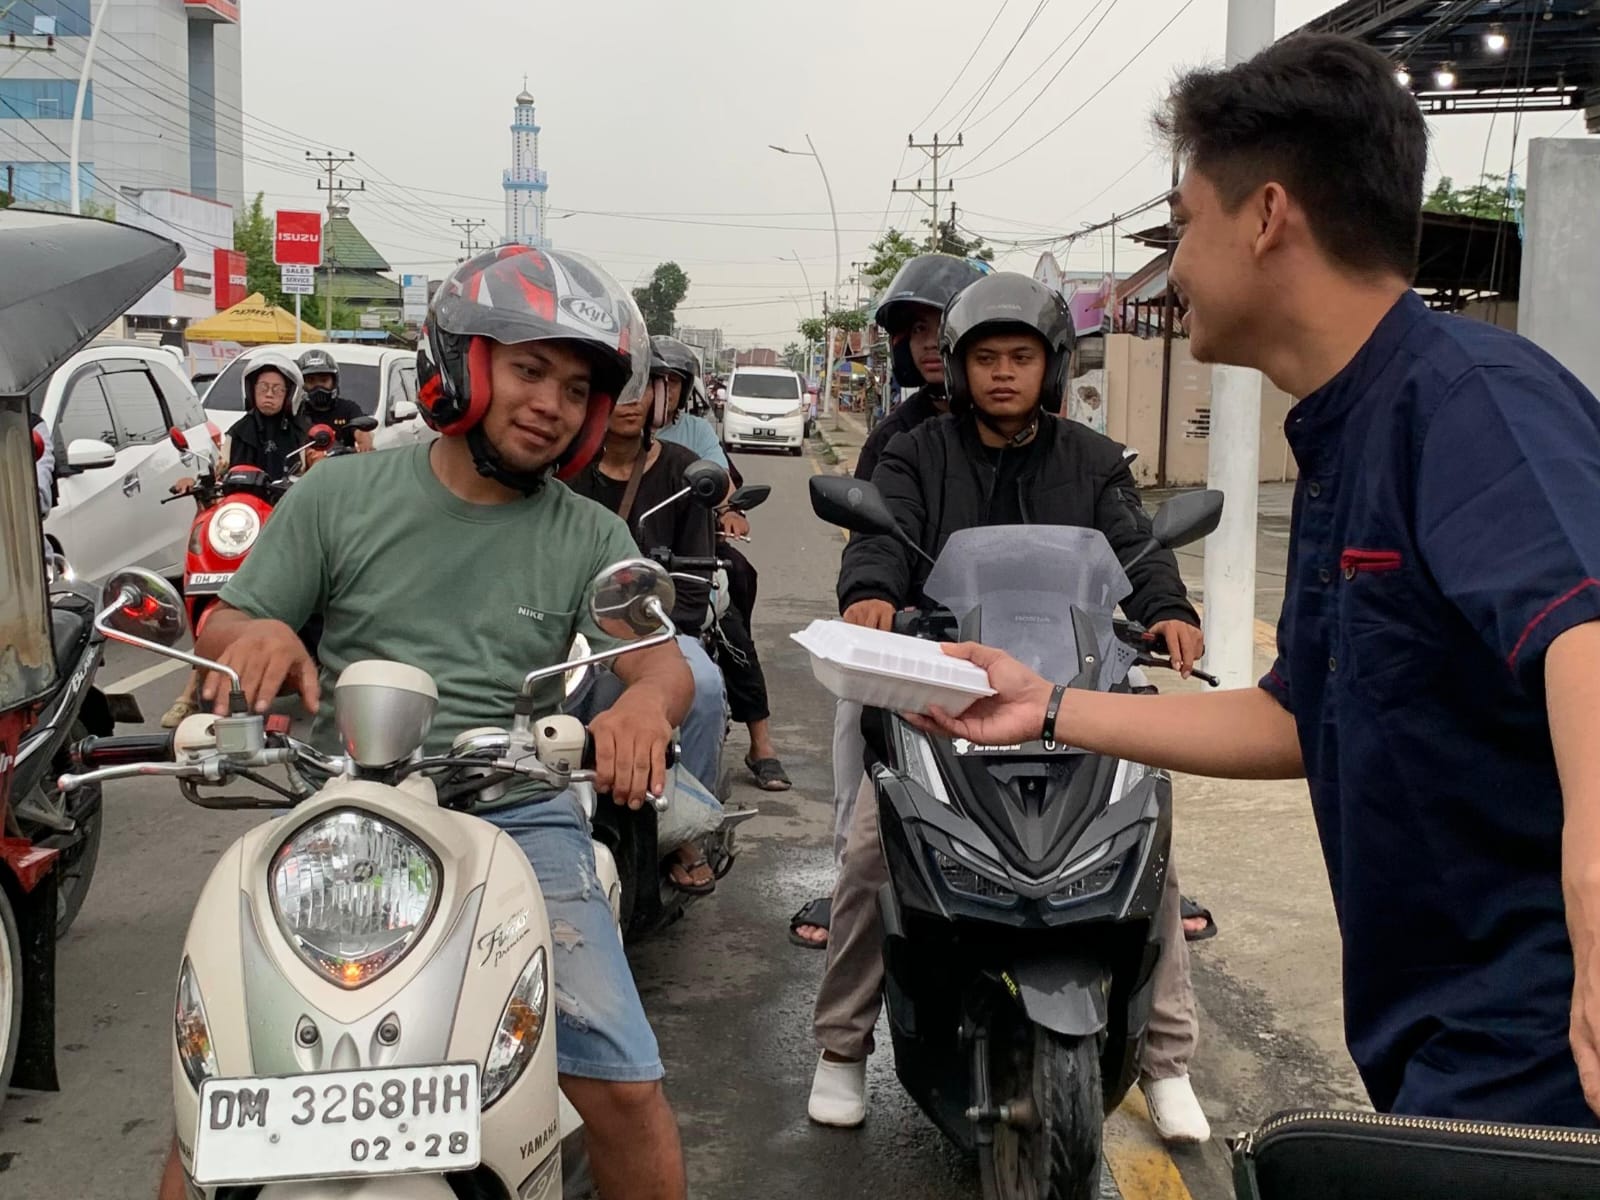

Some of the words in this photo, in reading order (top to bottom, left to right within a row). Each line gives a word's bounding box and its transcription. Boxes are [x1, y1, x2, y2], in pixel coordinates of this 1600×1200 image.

[278, 232, 319, 242] ISUZU
[518, 606, 545, 621] NIKE
[209, 1088, 269, 1130] DM
[519, 1118, 557, 1160] YAMAHA
